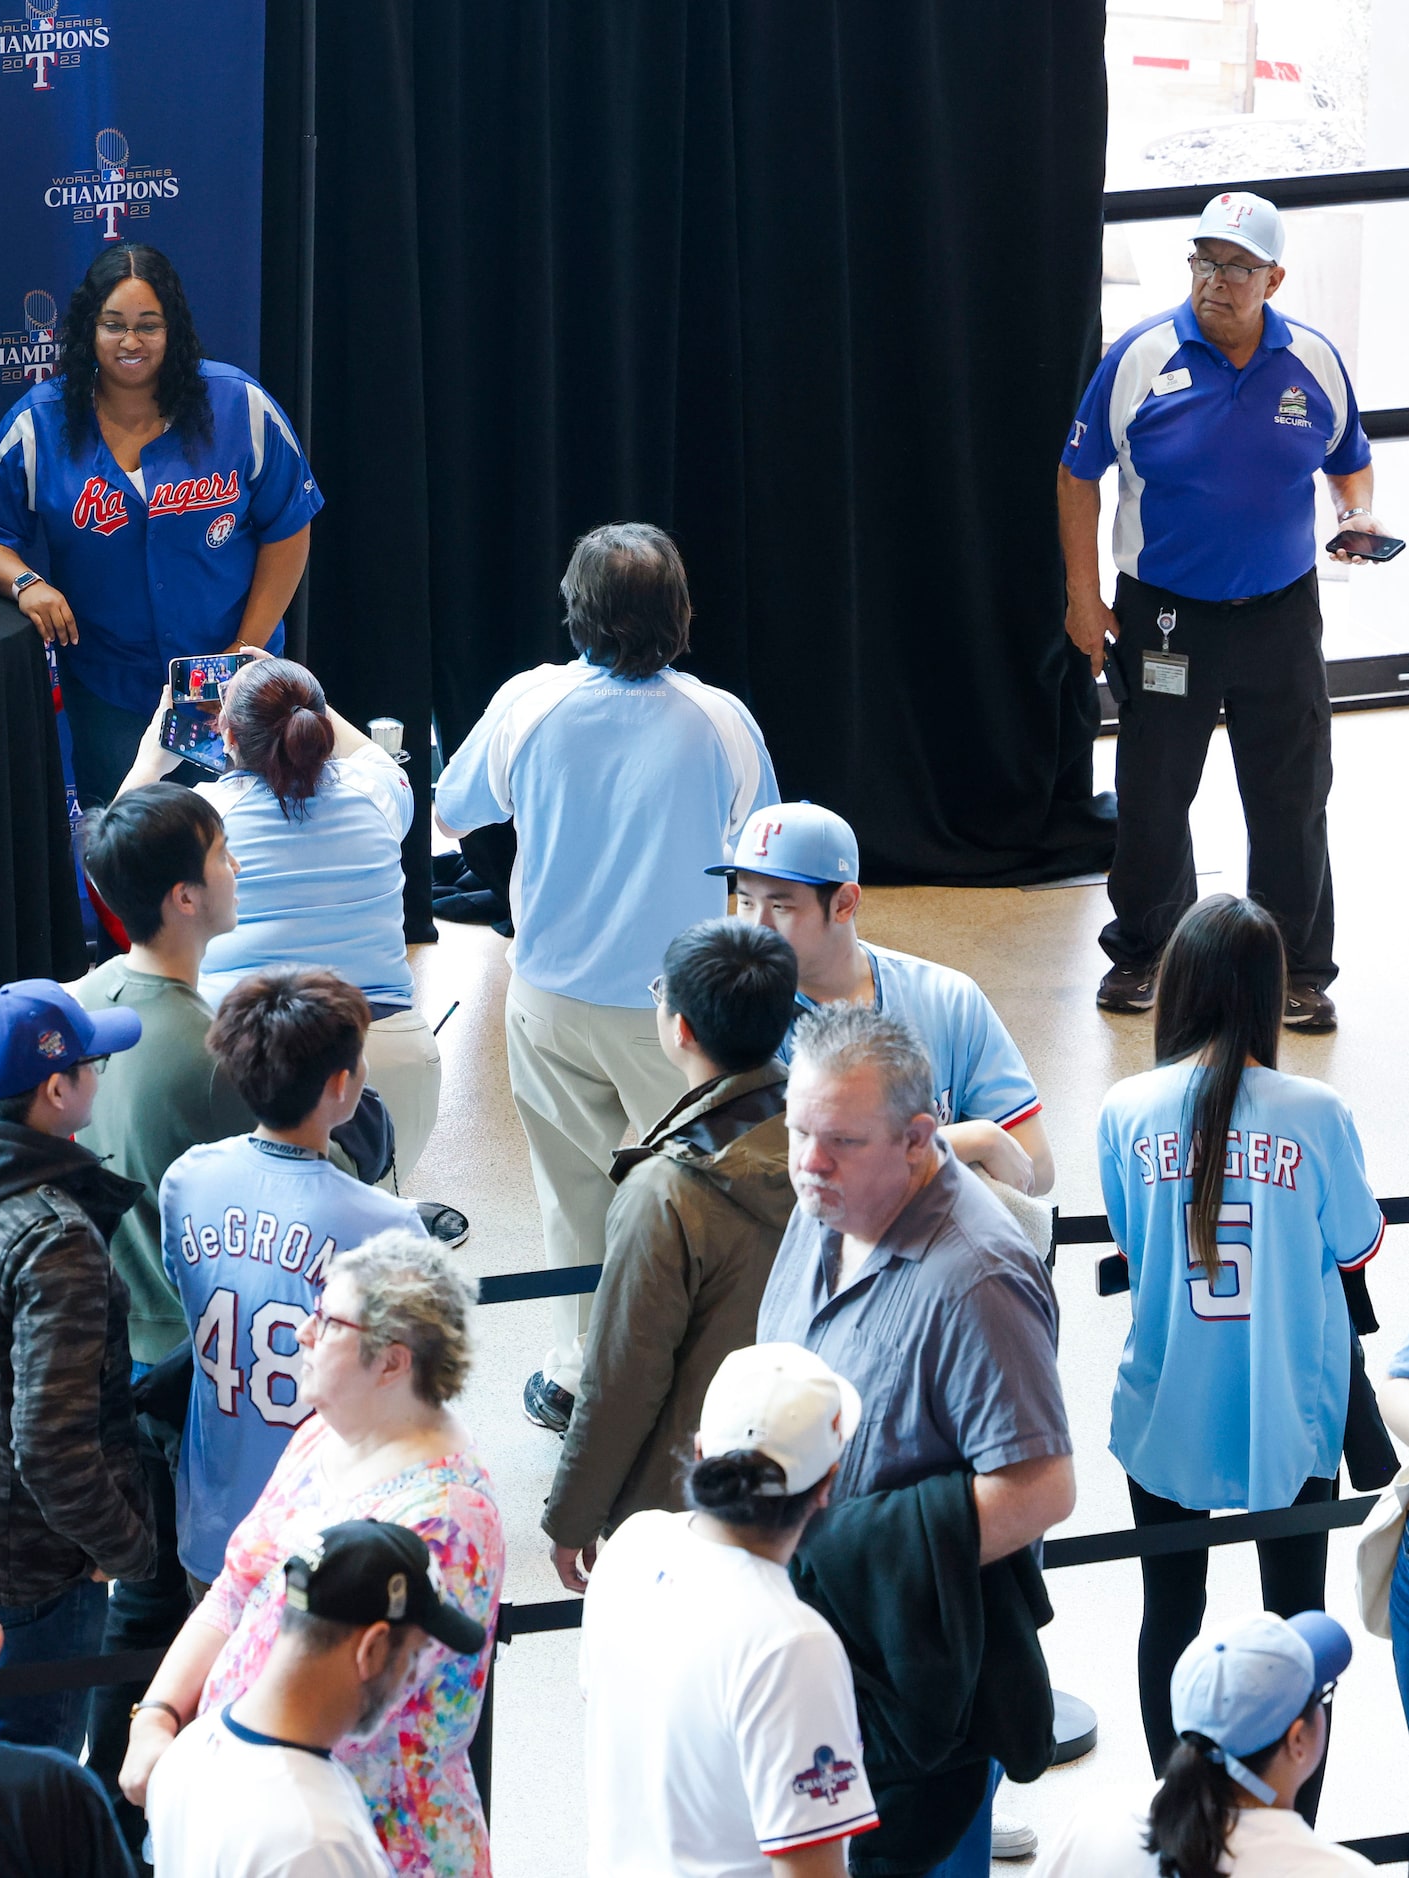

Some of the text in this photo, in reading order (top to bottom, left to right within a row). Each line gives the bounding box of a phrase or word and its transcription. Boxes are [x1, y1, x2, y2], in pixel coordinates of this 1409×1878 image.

[55, 18, 103, 29] SERIES
[2, 52, 81, 91] 20 T 23
[52, 169, 173, 185] WORLD SERIES
[44, 178, 179, 208] CHAMPIONS
[73, 202, 151, 241] 20 T 23
[1, 370, 22, 381] 20
[1070, 420, 1088, 449] T
[1274, 415, 1313, 429] SECURITY
[753, 820, 783, 856] T
[259, 1140, 307, 1156] COMBAT
[1184, 1202, 1253, 1322] 5
[194, 1286, 316, 1431] 48
